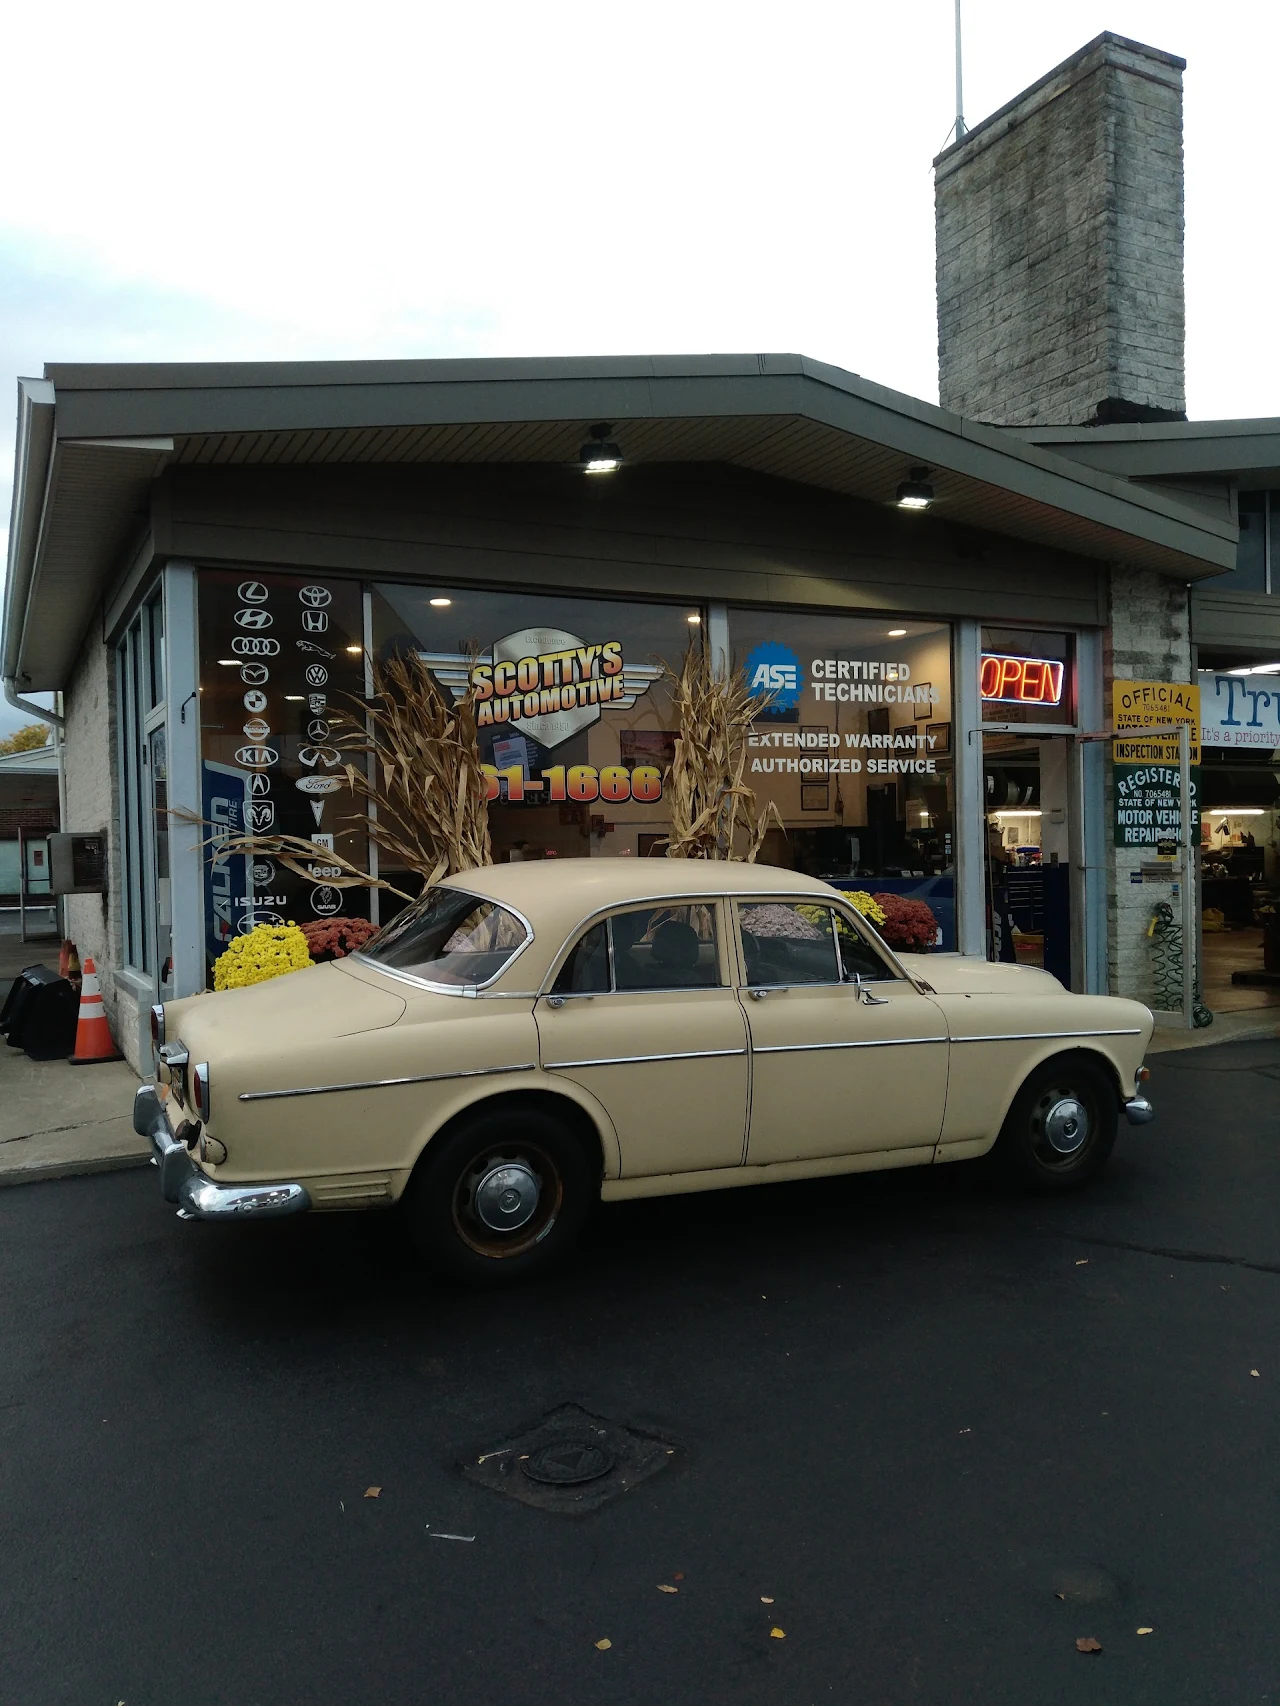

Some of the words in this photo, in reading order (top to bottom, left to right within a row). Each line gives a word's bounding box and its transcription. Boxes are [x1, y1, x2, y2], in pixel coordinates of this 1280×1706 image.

[472, 641, 623, 700] SCOTTY'S
[752, 663, 797, 690] ASE
[811, 659, 911, 682] CERTIFIED
[981, 658, 1061, 702] OPEN
[477, 674, 625, 728] AUTOMOTIVE
[811, 682, 941, 704] TECHNICIANS
[1121, 687, 1193, 713] OFFICIAL
[1215, 675, 1280, 728] Tr
[1117, 714, 1141, 724] STATE
[1143, 715, 1154, 724] OF
[1156, 716, 1173, 725] NEW
[1175, 717, 1196, 726] YORK
[748, 732, 841, 749] EXTENDED
[844, 733, 938, 750] WARRANTY
[1201, 727, 1220, 742] It's
[1223, 731, 1232, 742] a
[242, 750, 272, 763] KIA
[1116, 743, 1164, 760] INSPECTION
[750, 757, 862, 774] AUTHORIZED
[866, 759, 937, 774] SERVICE
[1117, 767, 1197, 797] REGISTERD
[1118, 798, 1143, 807] STATE
[1144, 798, 1156, 807] OF
[1157, 799, 1175, 807] NEW
[229, 799, 239, 829] TIRE
[1117, 809, 1153, 825] MOTOR
[1124, 827, 1161, 843] REPAIR
[234, 895, 288, 907] ISUZU
